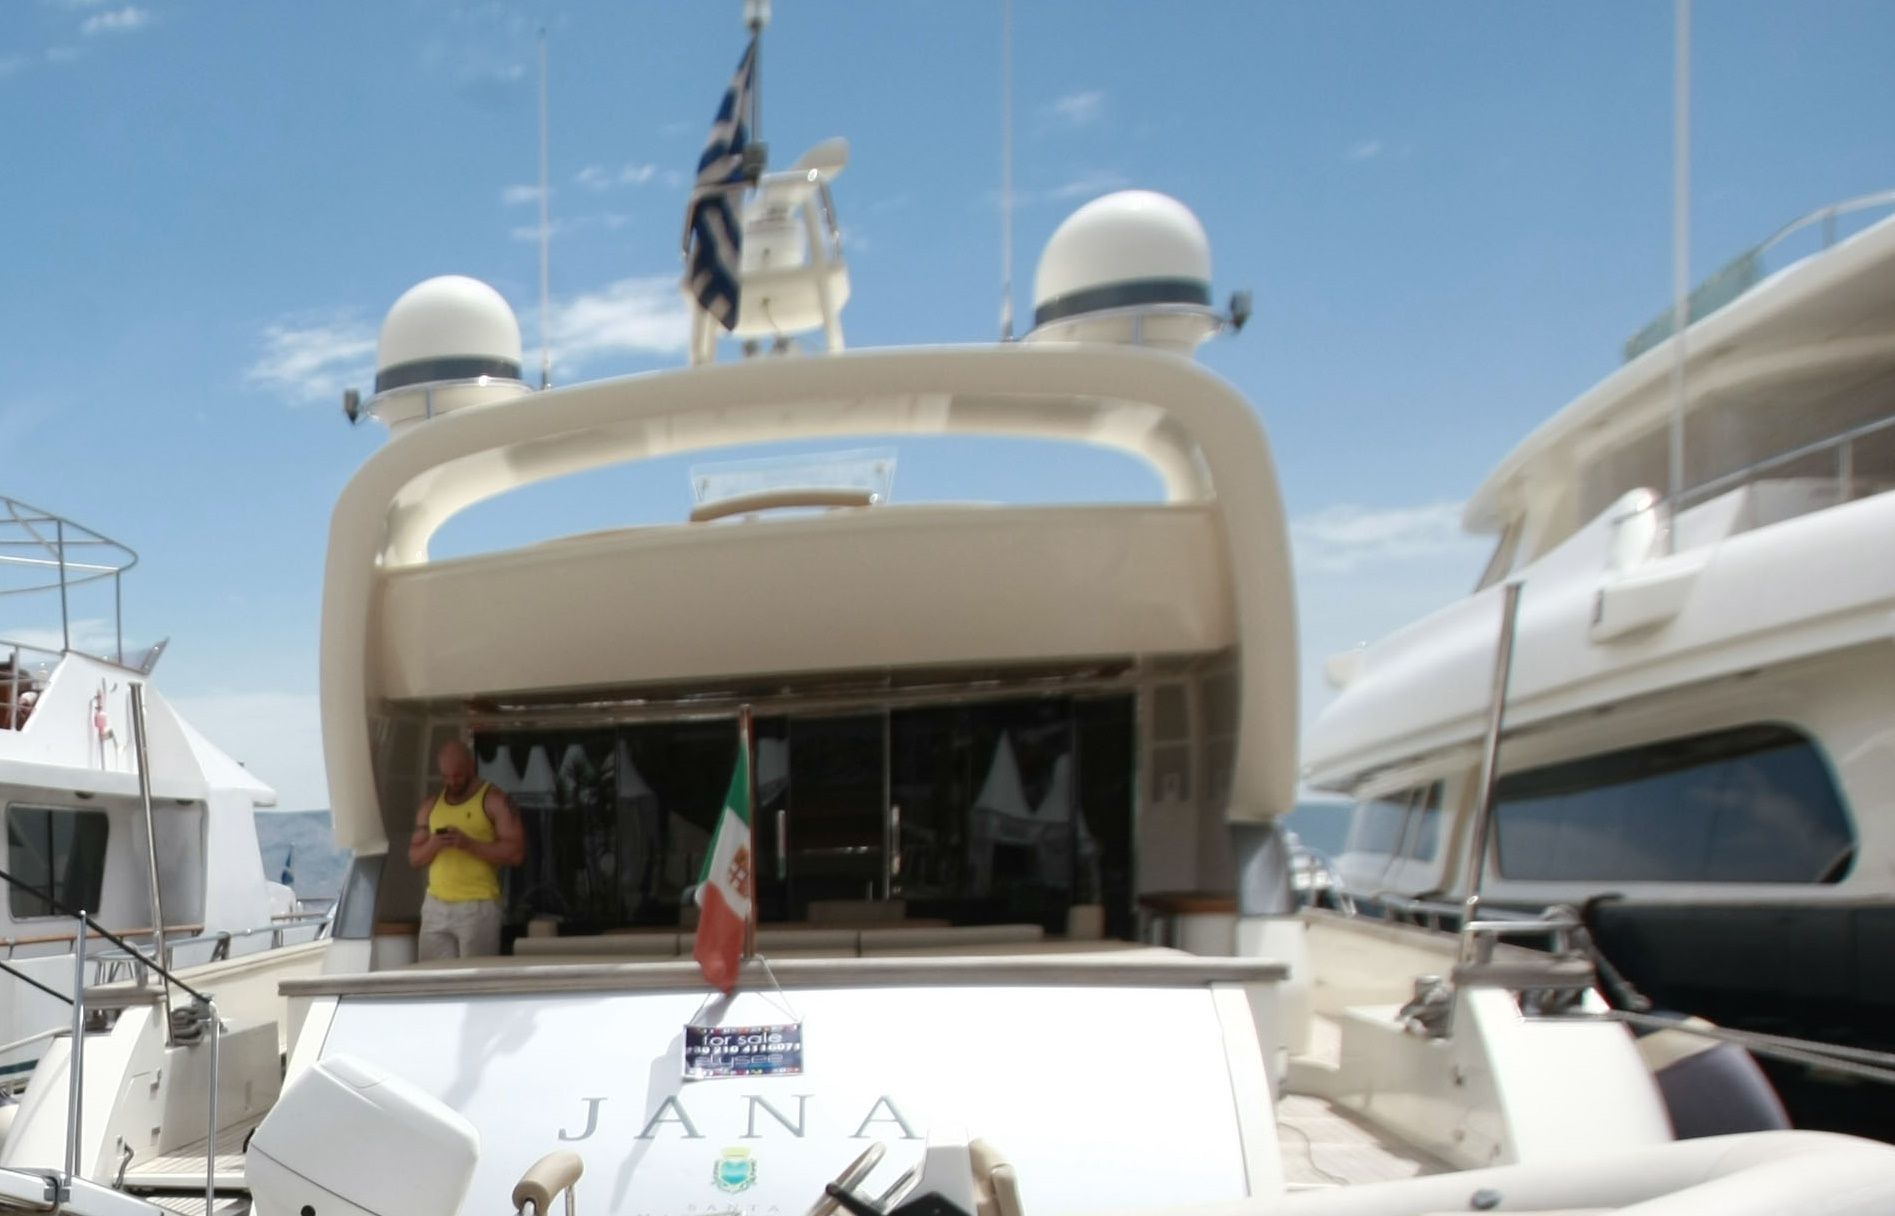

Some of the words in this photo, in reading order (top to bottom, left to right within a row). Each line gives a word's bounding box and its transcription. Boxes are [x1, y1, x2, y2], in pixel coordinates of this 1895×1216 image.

[703, 1033, 731, 1046] for
[737, 1031, 783, 1045] sale
[557, 1093, 925, 1142] JANA
